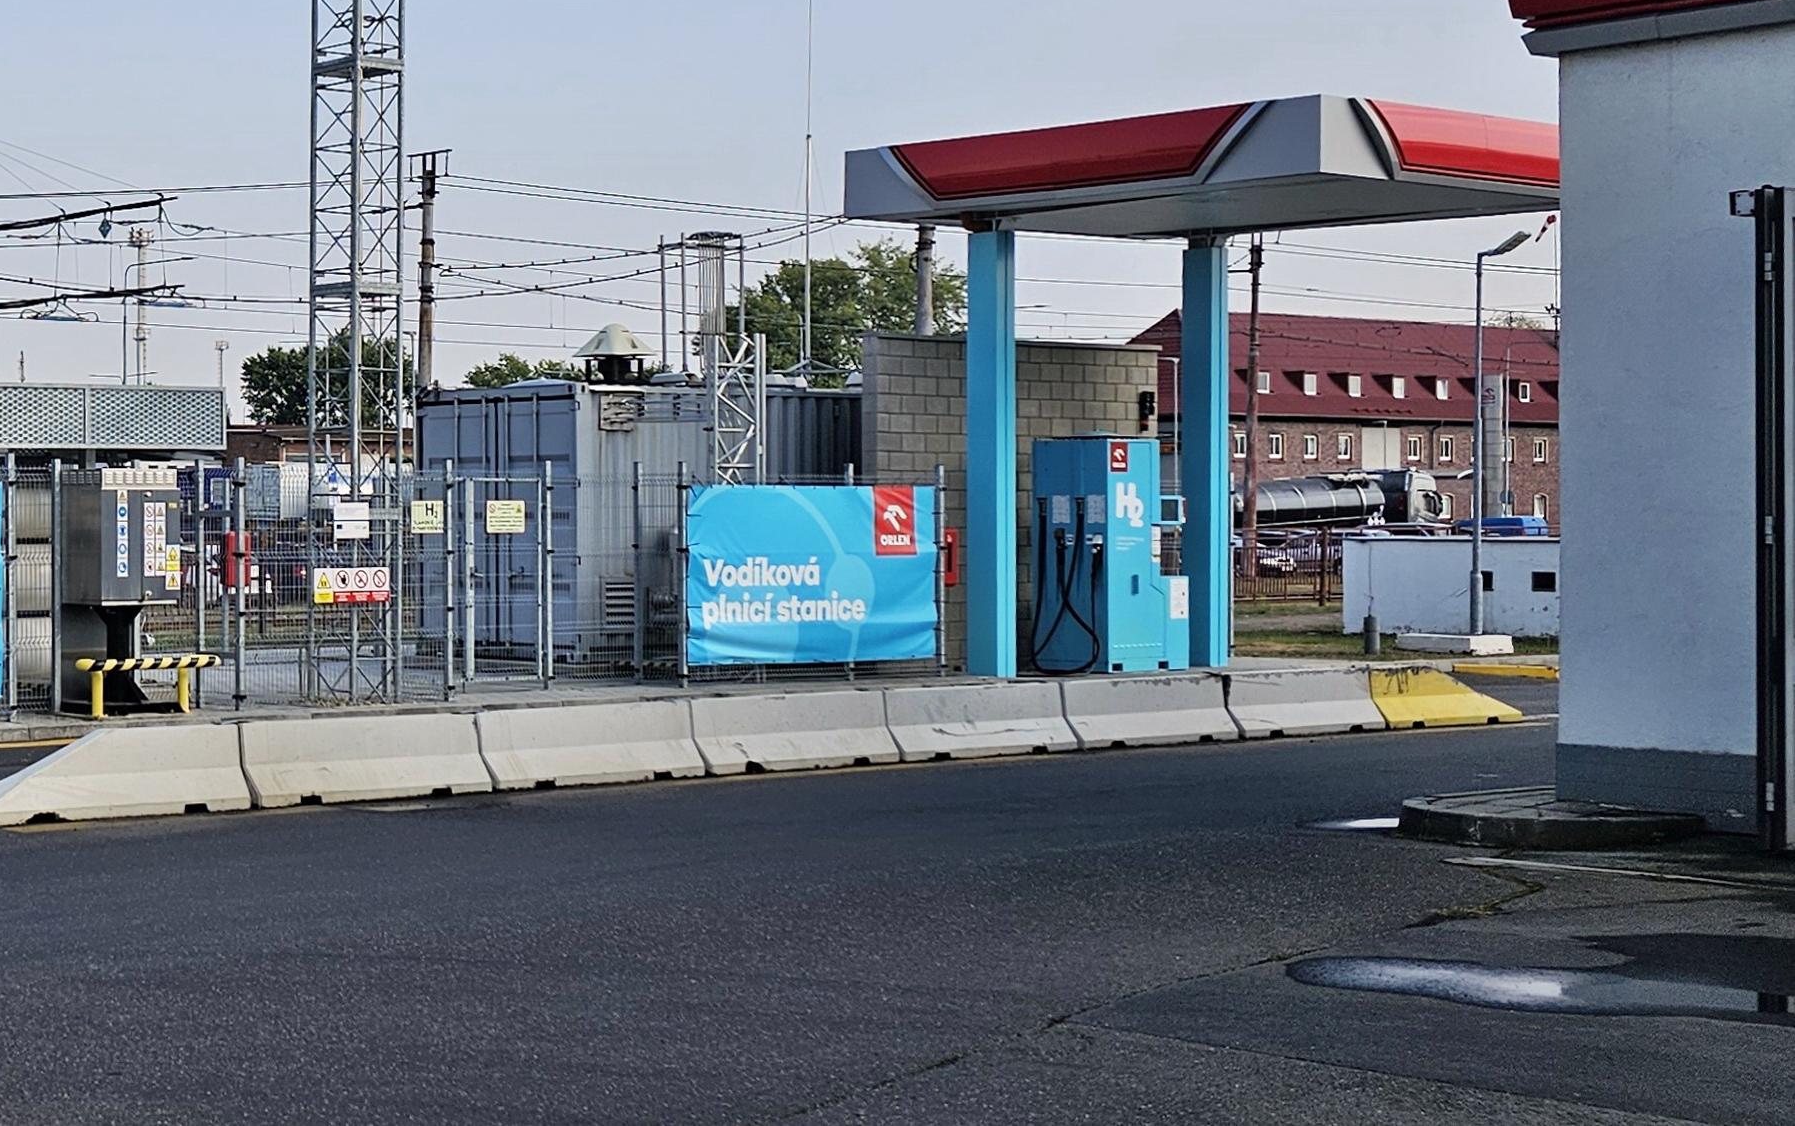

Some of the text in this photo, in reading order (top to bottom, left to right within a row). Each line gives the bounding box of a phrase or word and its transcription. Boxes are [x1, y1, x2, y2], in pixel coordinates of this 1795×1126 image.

[881, 534, 911, 546] ORLEN
[703, 557, 819, 587] Vodíková
[702, 591, 865, 630] plnicí stanice
